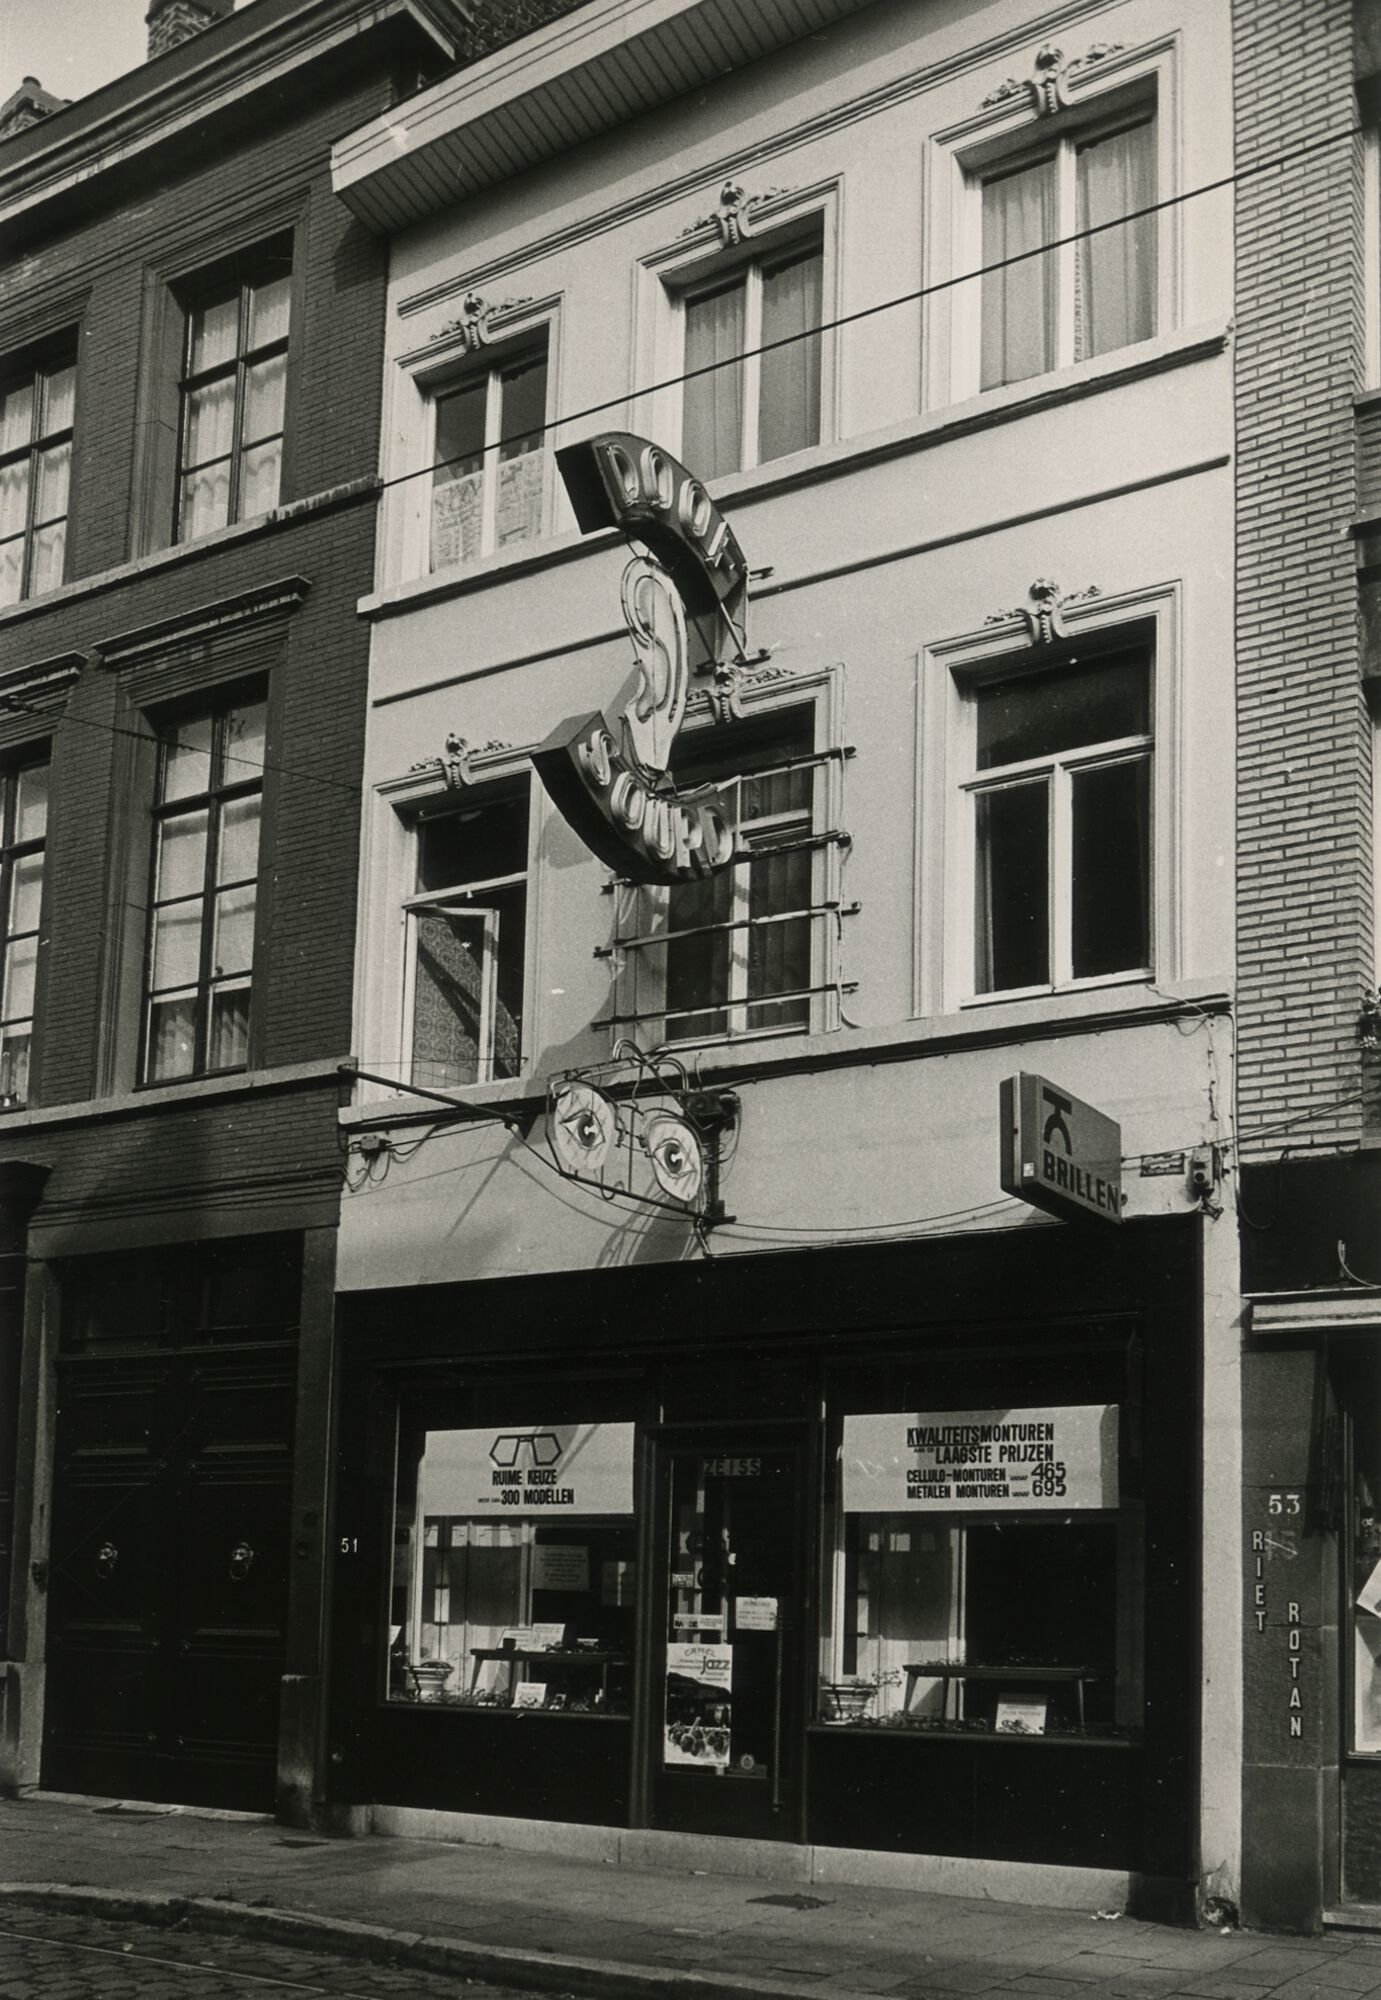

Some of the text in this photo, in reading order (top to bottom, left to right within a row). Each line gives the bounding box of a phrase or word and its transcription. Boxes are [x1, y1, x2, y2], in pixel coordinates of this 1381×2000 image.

[1042, 1149, 1120, 1214] BRILLEN
[906, 1423, 1054, 1446] KWALITEITSMONTUREN
[935, 1445, 992, 1464] LAAGSTE
[999, 1444, 1054, 1463] PRIJZEN
[704, 1459, 760, 1475] ZEISS
[906, 1468, 1006, 1483] CELLULO-MONTUREN
[1031, 1462, 1067, 1481] 465
[492, 1469, 557, 1486] RUIME KEUZE
[501, 1488, 575, 1505] 300 MODELLEN
[906, 1485, 951, 1499] METALEN
[956, 1484, 1010, 1498] MONTUREN
[1032, 1480, 1067, 1497] 695
[1268, 1494, 1300, 1515] 53
[341, 1537, 358, 1553] 51
[1253, 1530, 1266, 1632] RIET
[700, 1656, 730, 1675] jazz
[1288, 1602, 1302, 1737] ROTAN
